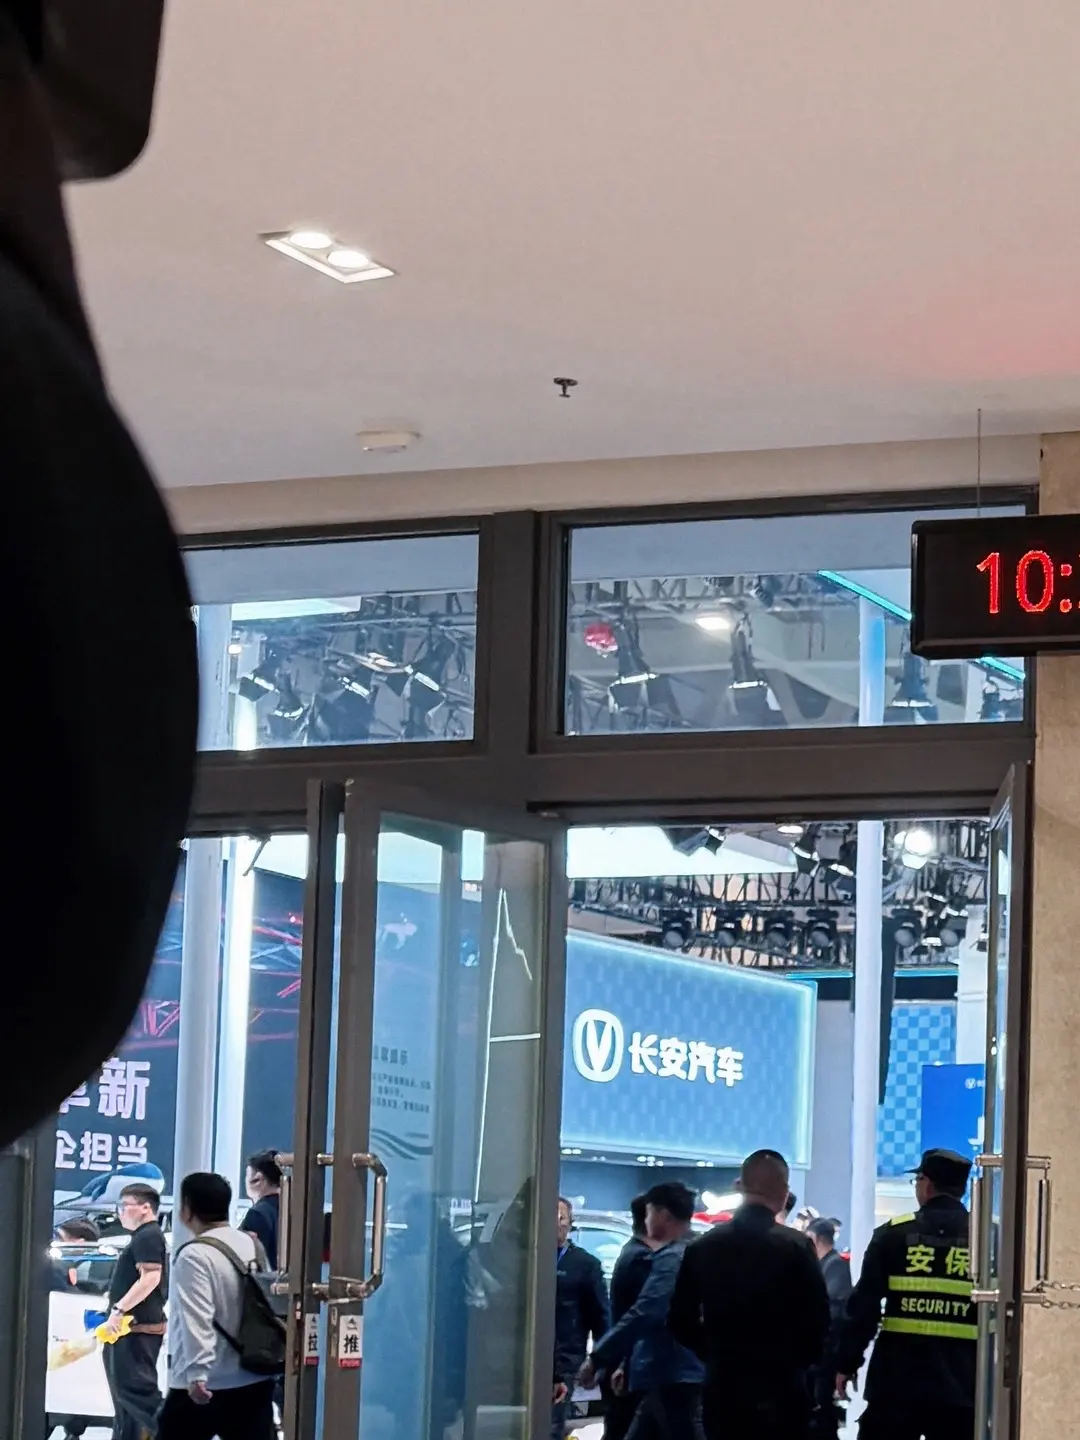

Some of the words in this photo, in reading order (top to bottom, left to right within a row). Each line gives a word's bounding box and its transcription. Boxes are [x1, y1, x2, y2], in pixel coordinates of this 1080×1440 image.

[628, 1031, 744, 1087] 长安汽车
[906, 1245, 970, 1276] 安保
[900, 1297, 971, 1317] SECURITY
[343, 1334, 360, 1354] 推
